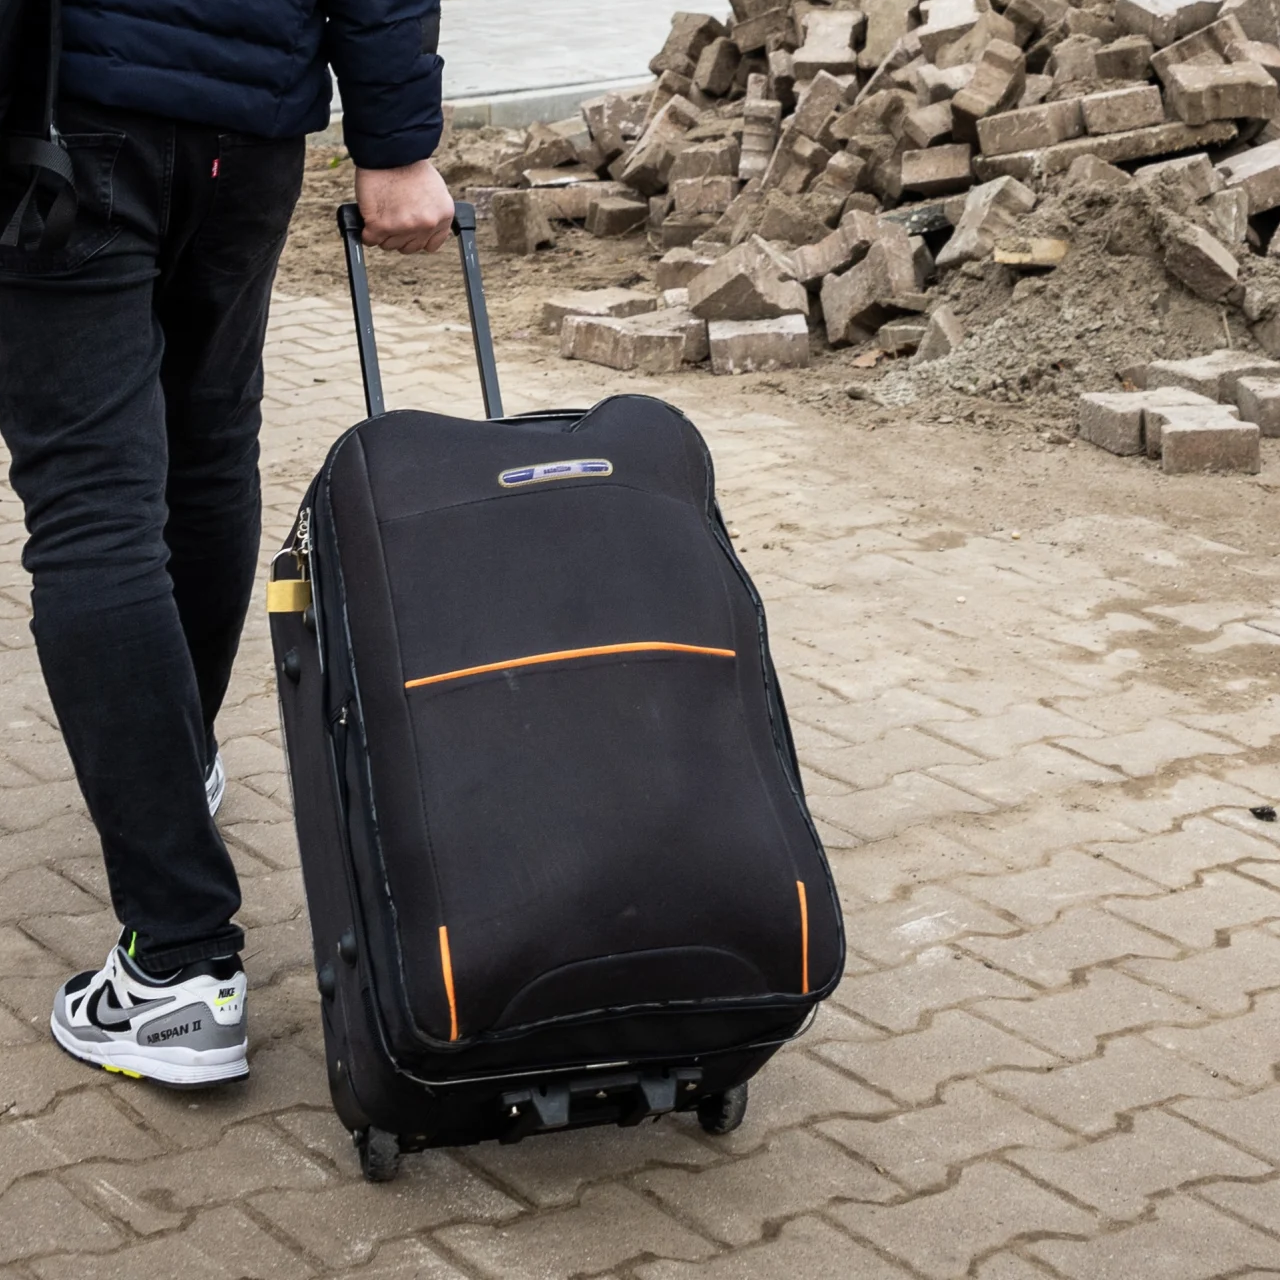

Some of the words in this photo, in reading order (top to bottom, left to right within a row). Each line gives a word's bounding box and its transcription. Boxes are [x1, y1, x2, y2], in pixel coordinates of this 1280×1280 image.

[218, 987, 236, 999] NIKE
[220, 1004, 238, 1012] AIR
[192, 1019, 202, 1032] II
